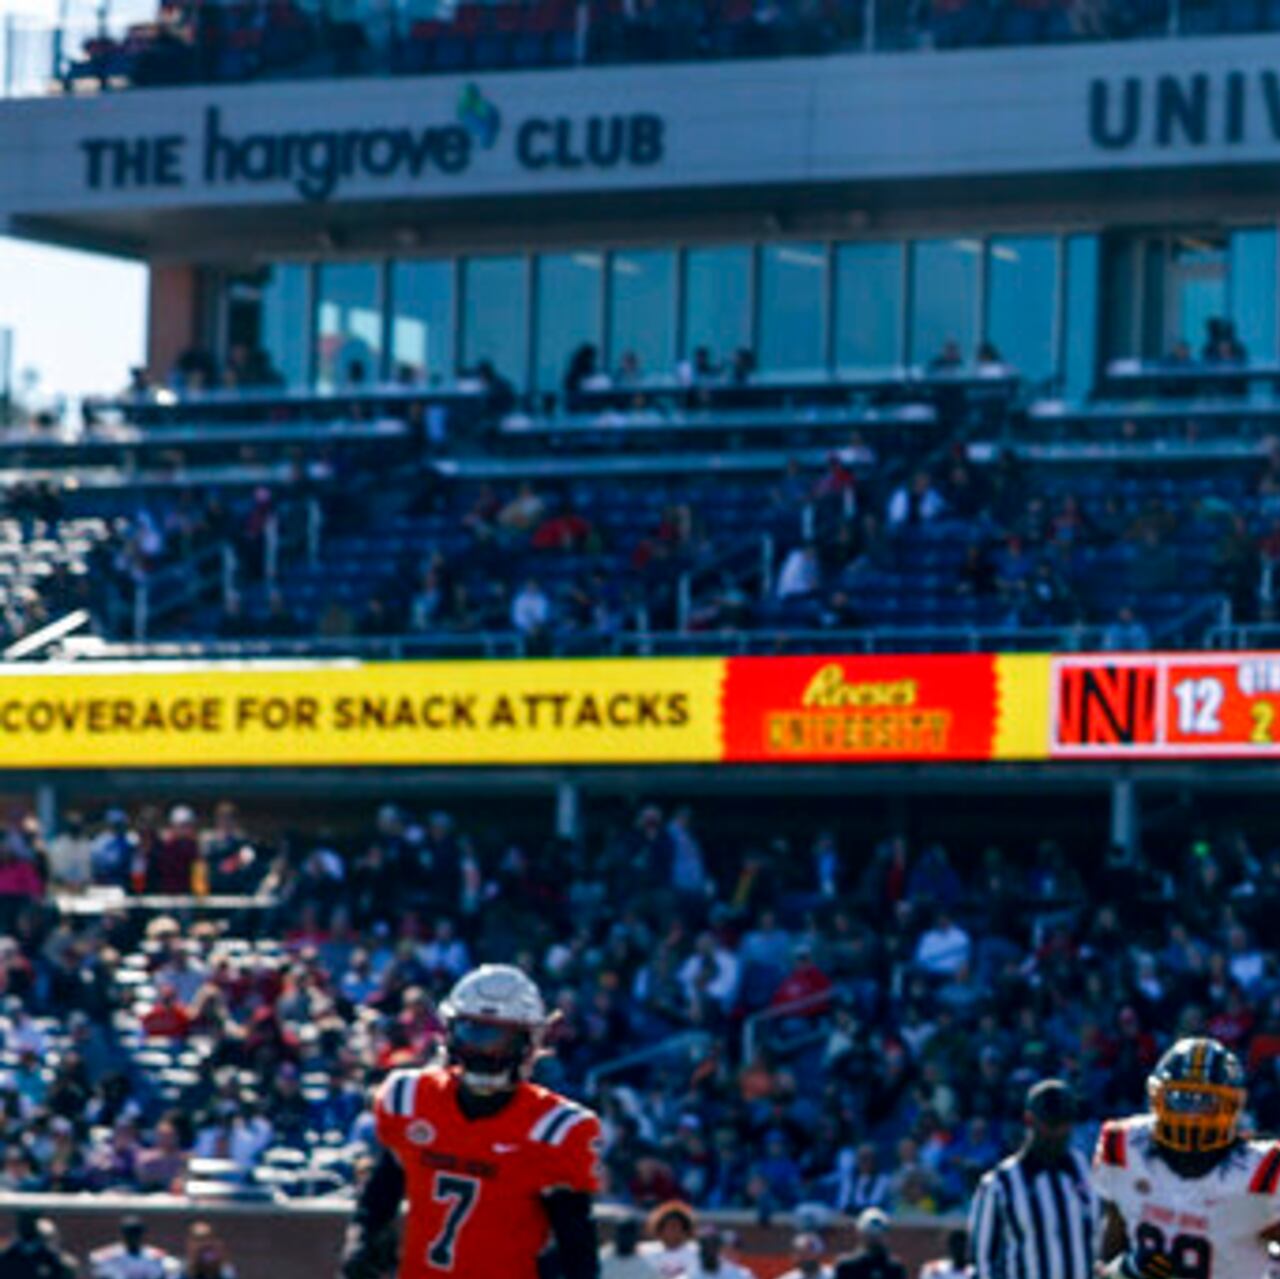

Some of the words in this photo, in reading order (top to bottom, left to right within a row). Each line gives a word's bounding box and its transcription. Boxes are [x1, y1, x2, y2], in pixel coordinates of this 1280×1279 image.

[80, 136, 184, 188] THE
[204, 104, 471, 200] hargrove
[516, 113, 665, 170] CLUB
[2, 700, 221, 734] COVERAGE
[234, 697, 318, 733] FOR
[334, 695, 477, 731] SNACK
[488, 692, 690, 729] ATTACKS
[1174, 677, 1225, 735] 12
[1249, 701, 1275, 743] 2
[426, 1169, 482, 1273] 7
